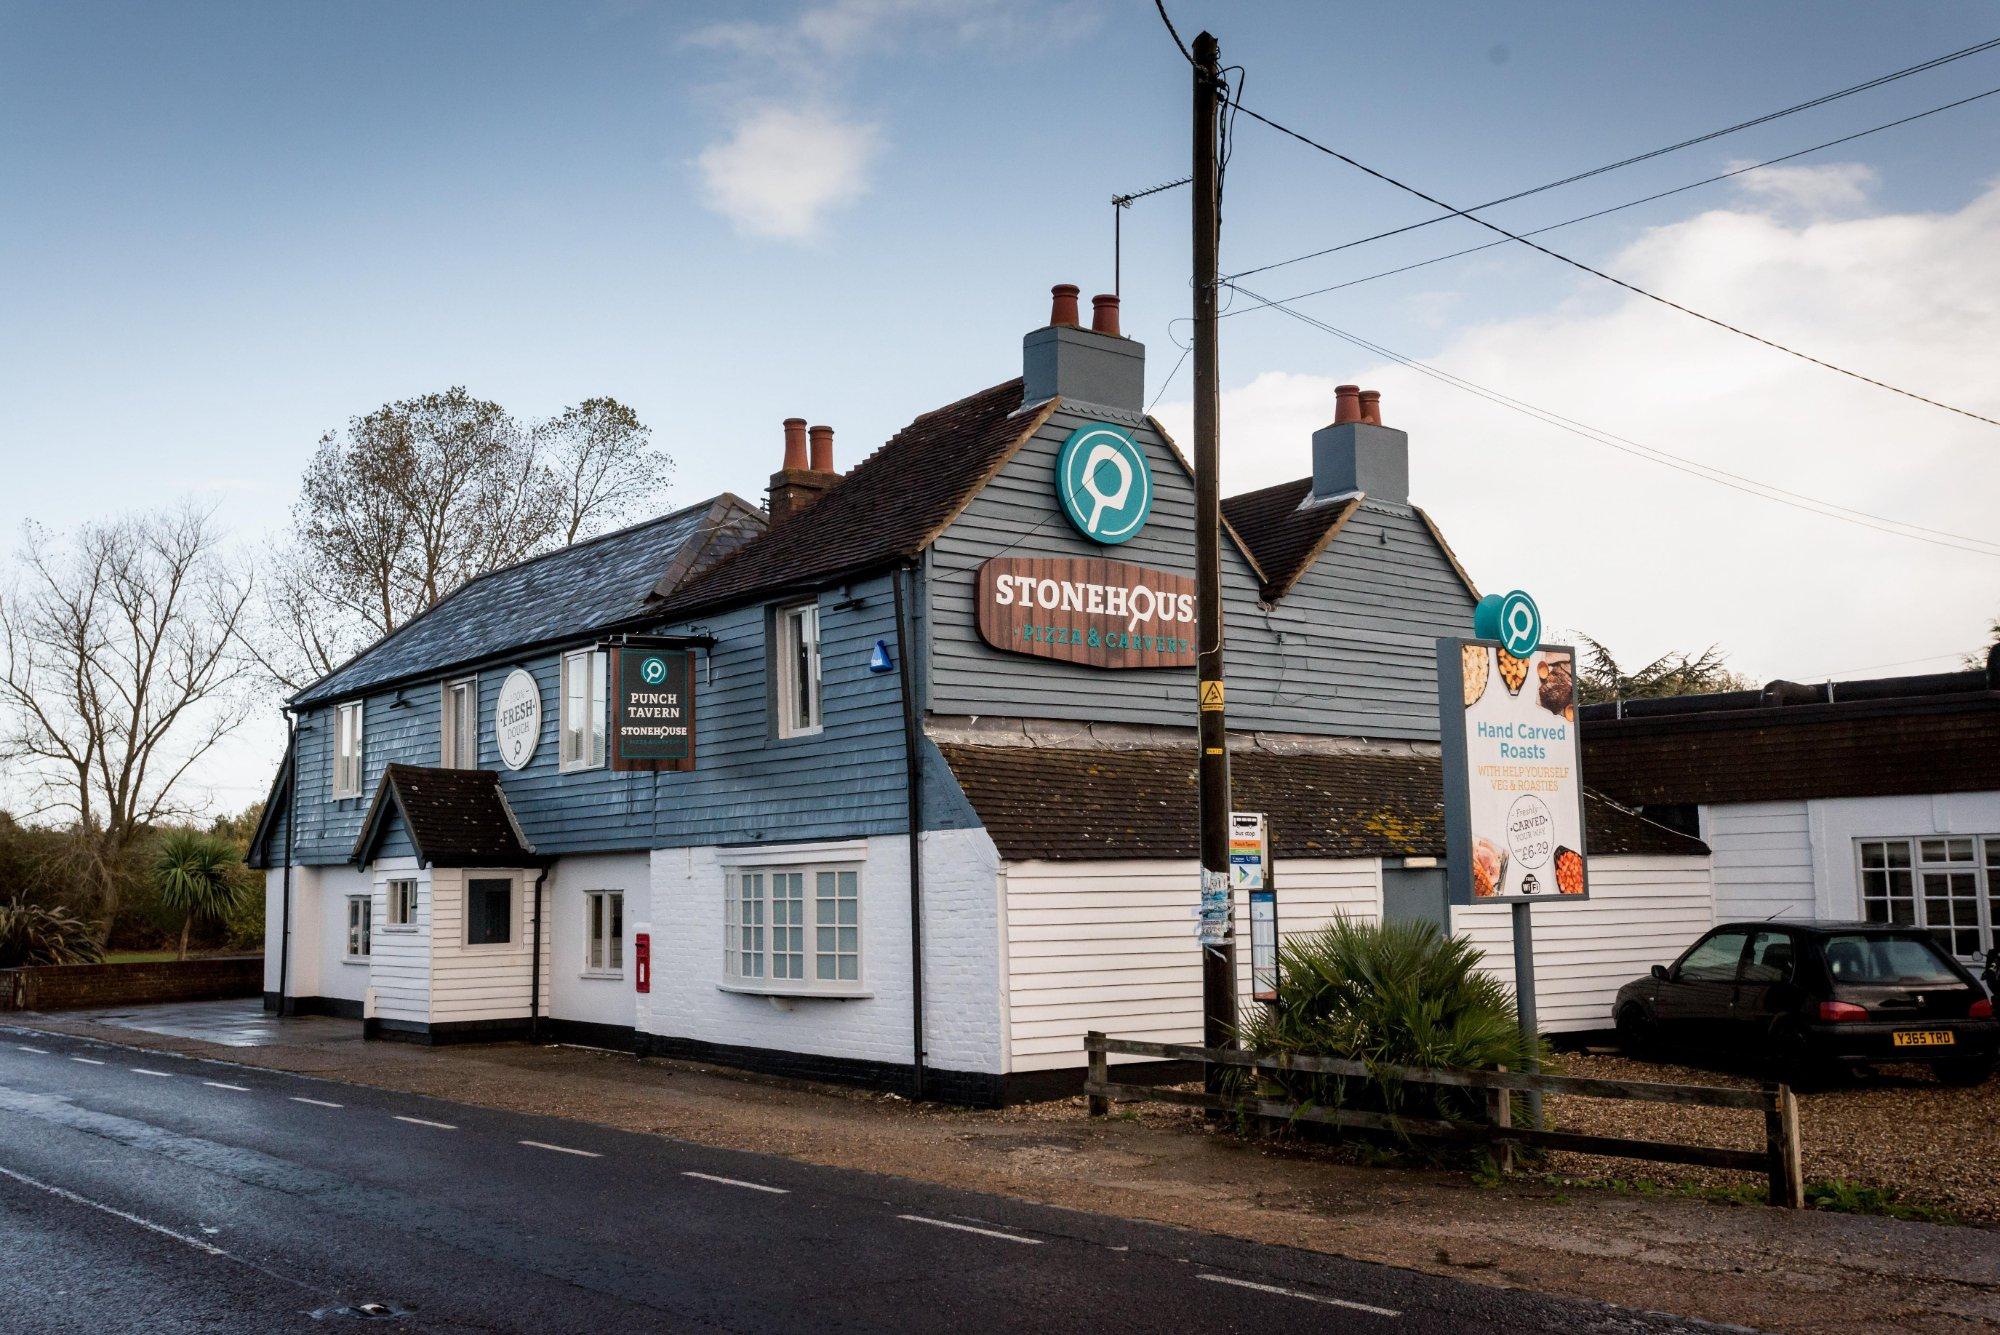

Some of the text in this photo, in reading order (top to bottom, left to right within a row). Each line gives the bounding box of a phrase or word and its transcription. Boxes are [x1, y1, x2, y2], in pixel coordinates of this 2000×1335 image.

[996, 574, 1197, 633] STONEHOUS
[1023, 624, 1188, 653] PIZZA & CARVERY
[630, 692, 677, 704] PUNCH
[503, 700, 533, 727] FRESH
[628, 707, 680, 718] TAVERN
[621, 726, 687, 739] STONEHOUSE
[1478, 722, 1566, 740] Hand Carved
[1500, 743, 1546, 759] Roasts
[1478, 765, 1569, 779] WITH HELP YOURSELF
[1491, 780, 1509, 791] VEG
[1518, 780, 1559, 792] ROASTIES
[1512, 815, 1546, 832] CARVED
[1897, 1032, 1950, 1045] Y365 TRD
